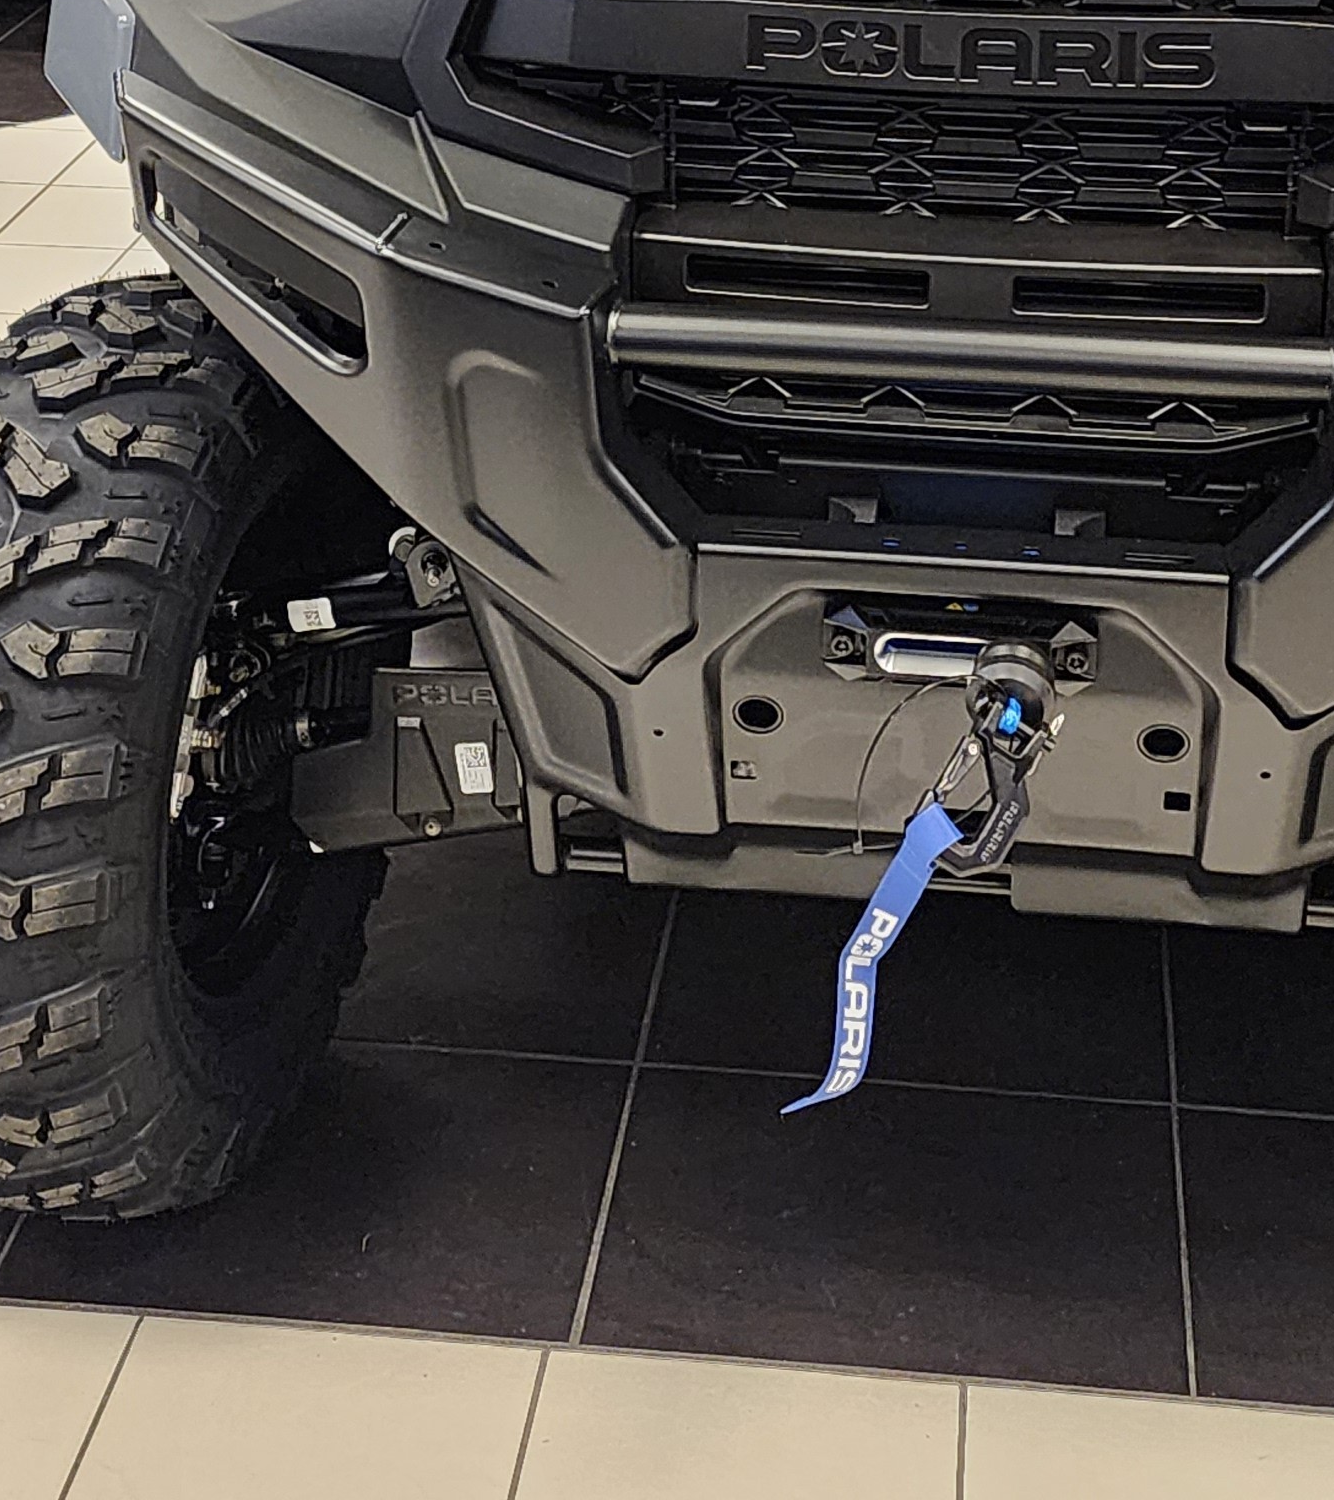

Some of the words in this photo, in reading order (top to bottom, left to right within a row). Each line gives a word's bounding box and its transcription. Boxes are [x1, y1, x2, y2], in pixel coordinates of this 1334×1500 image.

[746, 14, 1217, 89] POLARIS
[392, 684, 499, 707] POLA
[825, 907, 899, 1094] POLARIS
